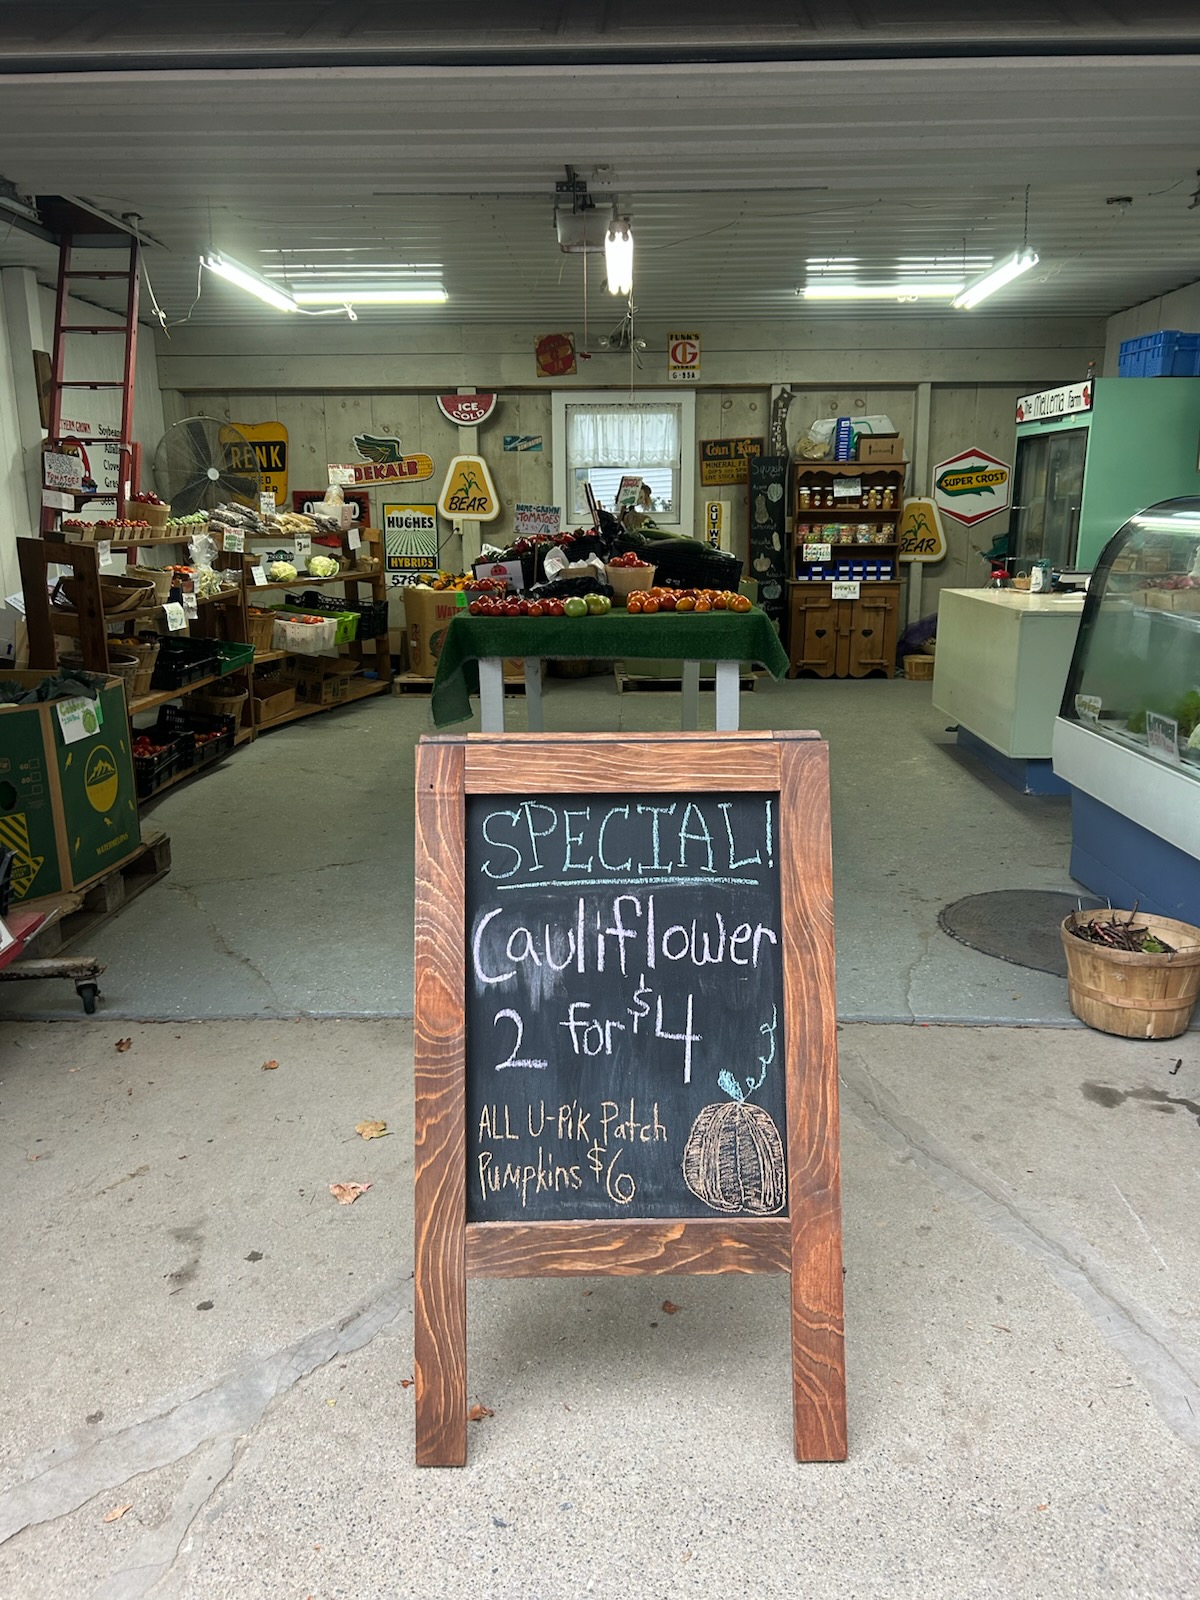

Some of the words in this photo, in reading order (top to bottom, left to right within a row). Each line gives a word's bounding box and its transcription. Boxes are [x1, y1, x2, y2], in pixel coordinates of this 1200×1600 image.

[671, 333, 700, 341] FUNK'S
[458, 402, 479, 411] ICE
[1025, 400, 1033, 414] The
[1034, 392, 1064, 417] Mellema
[1068, 390, 1081, 409] Farm
[452, 409, 485, 421] COLD
[98, 424, 121, 438] Soybean
[230, 444, 283, 470] RENK
[705, 442, 729, 457] Corn
[737, 439, 761, 459] King
[103, 459, 120, 473] Clove
[355, 461, 418, 481] DEKALB
[705, 461, 737, 470] MINERAL
[751, 457, 784, 479] Squash
[944, 476, 973, 487] SUPER
[976, 472, 1005, 483] CROST
[448, 496, 488, 512] BEAR
[387, 516, 435, 530] HUGHES
[518, 512, 560, 525] TOMATOES
[899, 536, 935, 554] BEAR
[390, 557, 434, 568] HYBRIDS
[96, 833, 128, 855] WATERMELONS
[480, 799, 776, 879] SPECIAL!
[472, 894, 778, 984] Cauliflower
[493, 1008, 548, 1072] 2
[559, 1001, 626, 1057] for
[627, 972, 704, 1084] $4
[478, 1103, 519, 1143] ALL
[600, 1101, 669, 1143] Patch
[478, 1151, 583, 1207] Pumpkins
[585, 1137, 637, 1205] $6
